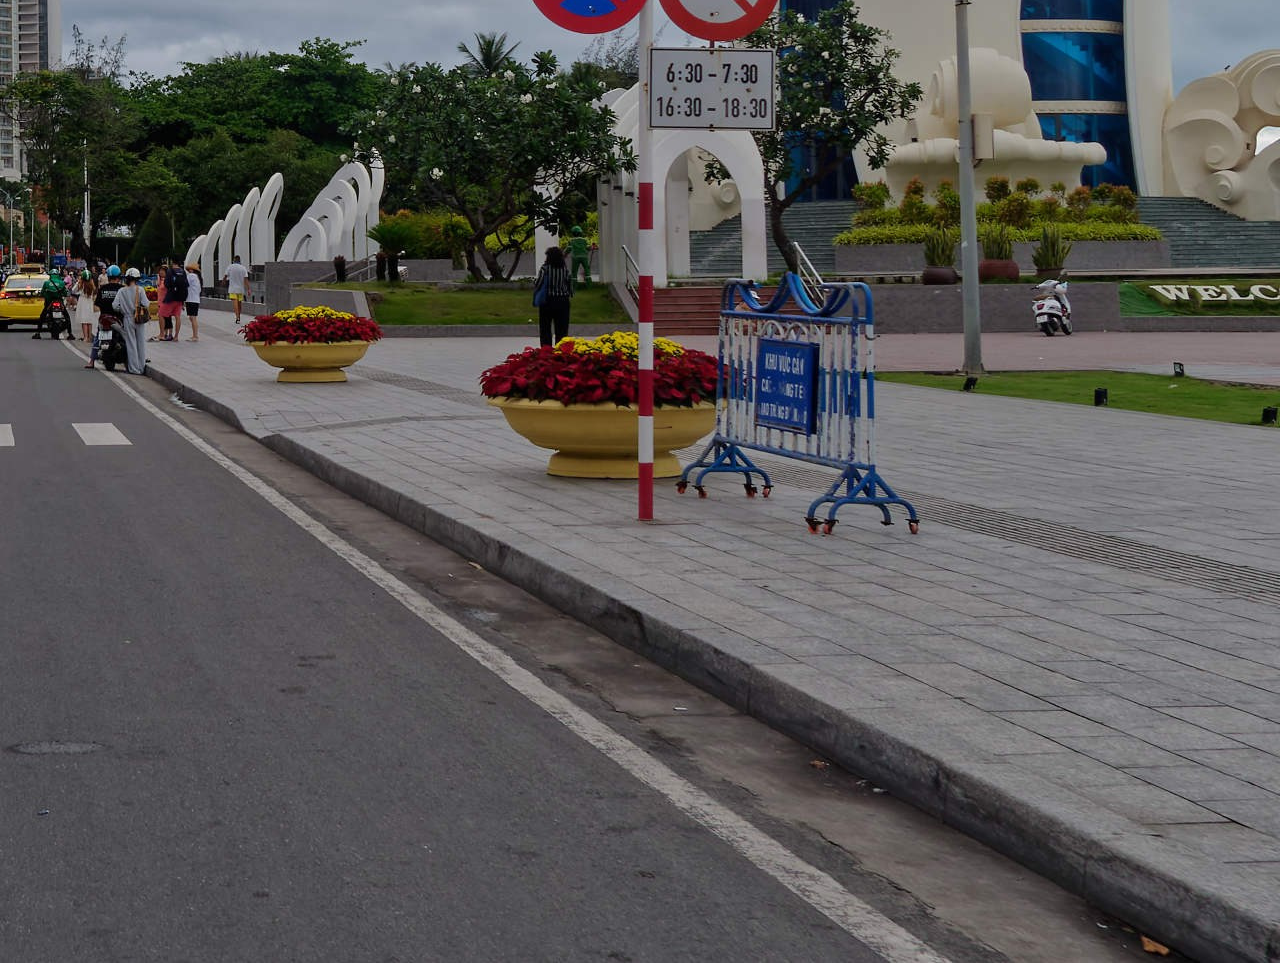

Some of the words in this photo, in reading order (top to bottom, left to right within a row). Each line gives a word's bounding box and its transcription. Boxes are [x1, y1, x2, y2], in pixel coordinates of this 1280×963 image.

[666, 63, 703, 83] 6:30
[722, 63, 758, 84] 7:30
[657, 97, 702, 118] 16:30
[723, 97, 767, 118] 18:30
[1148, 284, 1280, 300] WELC
